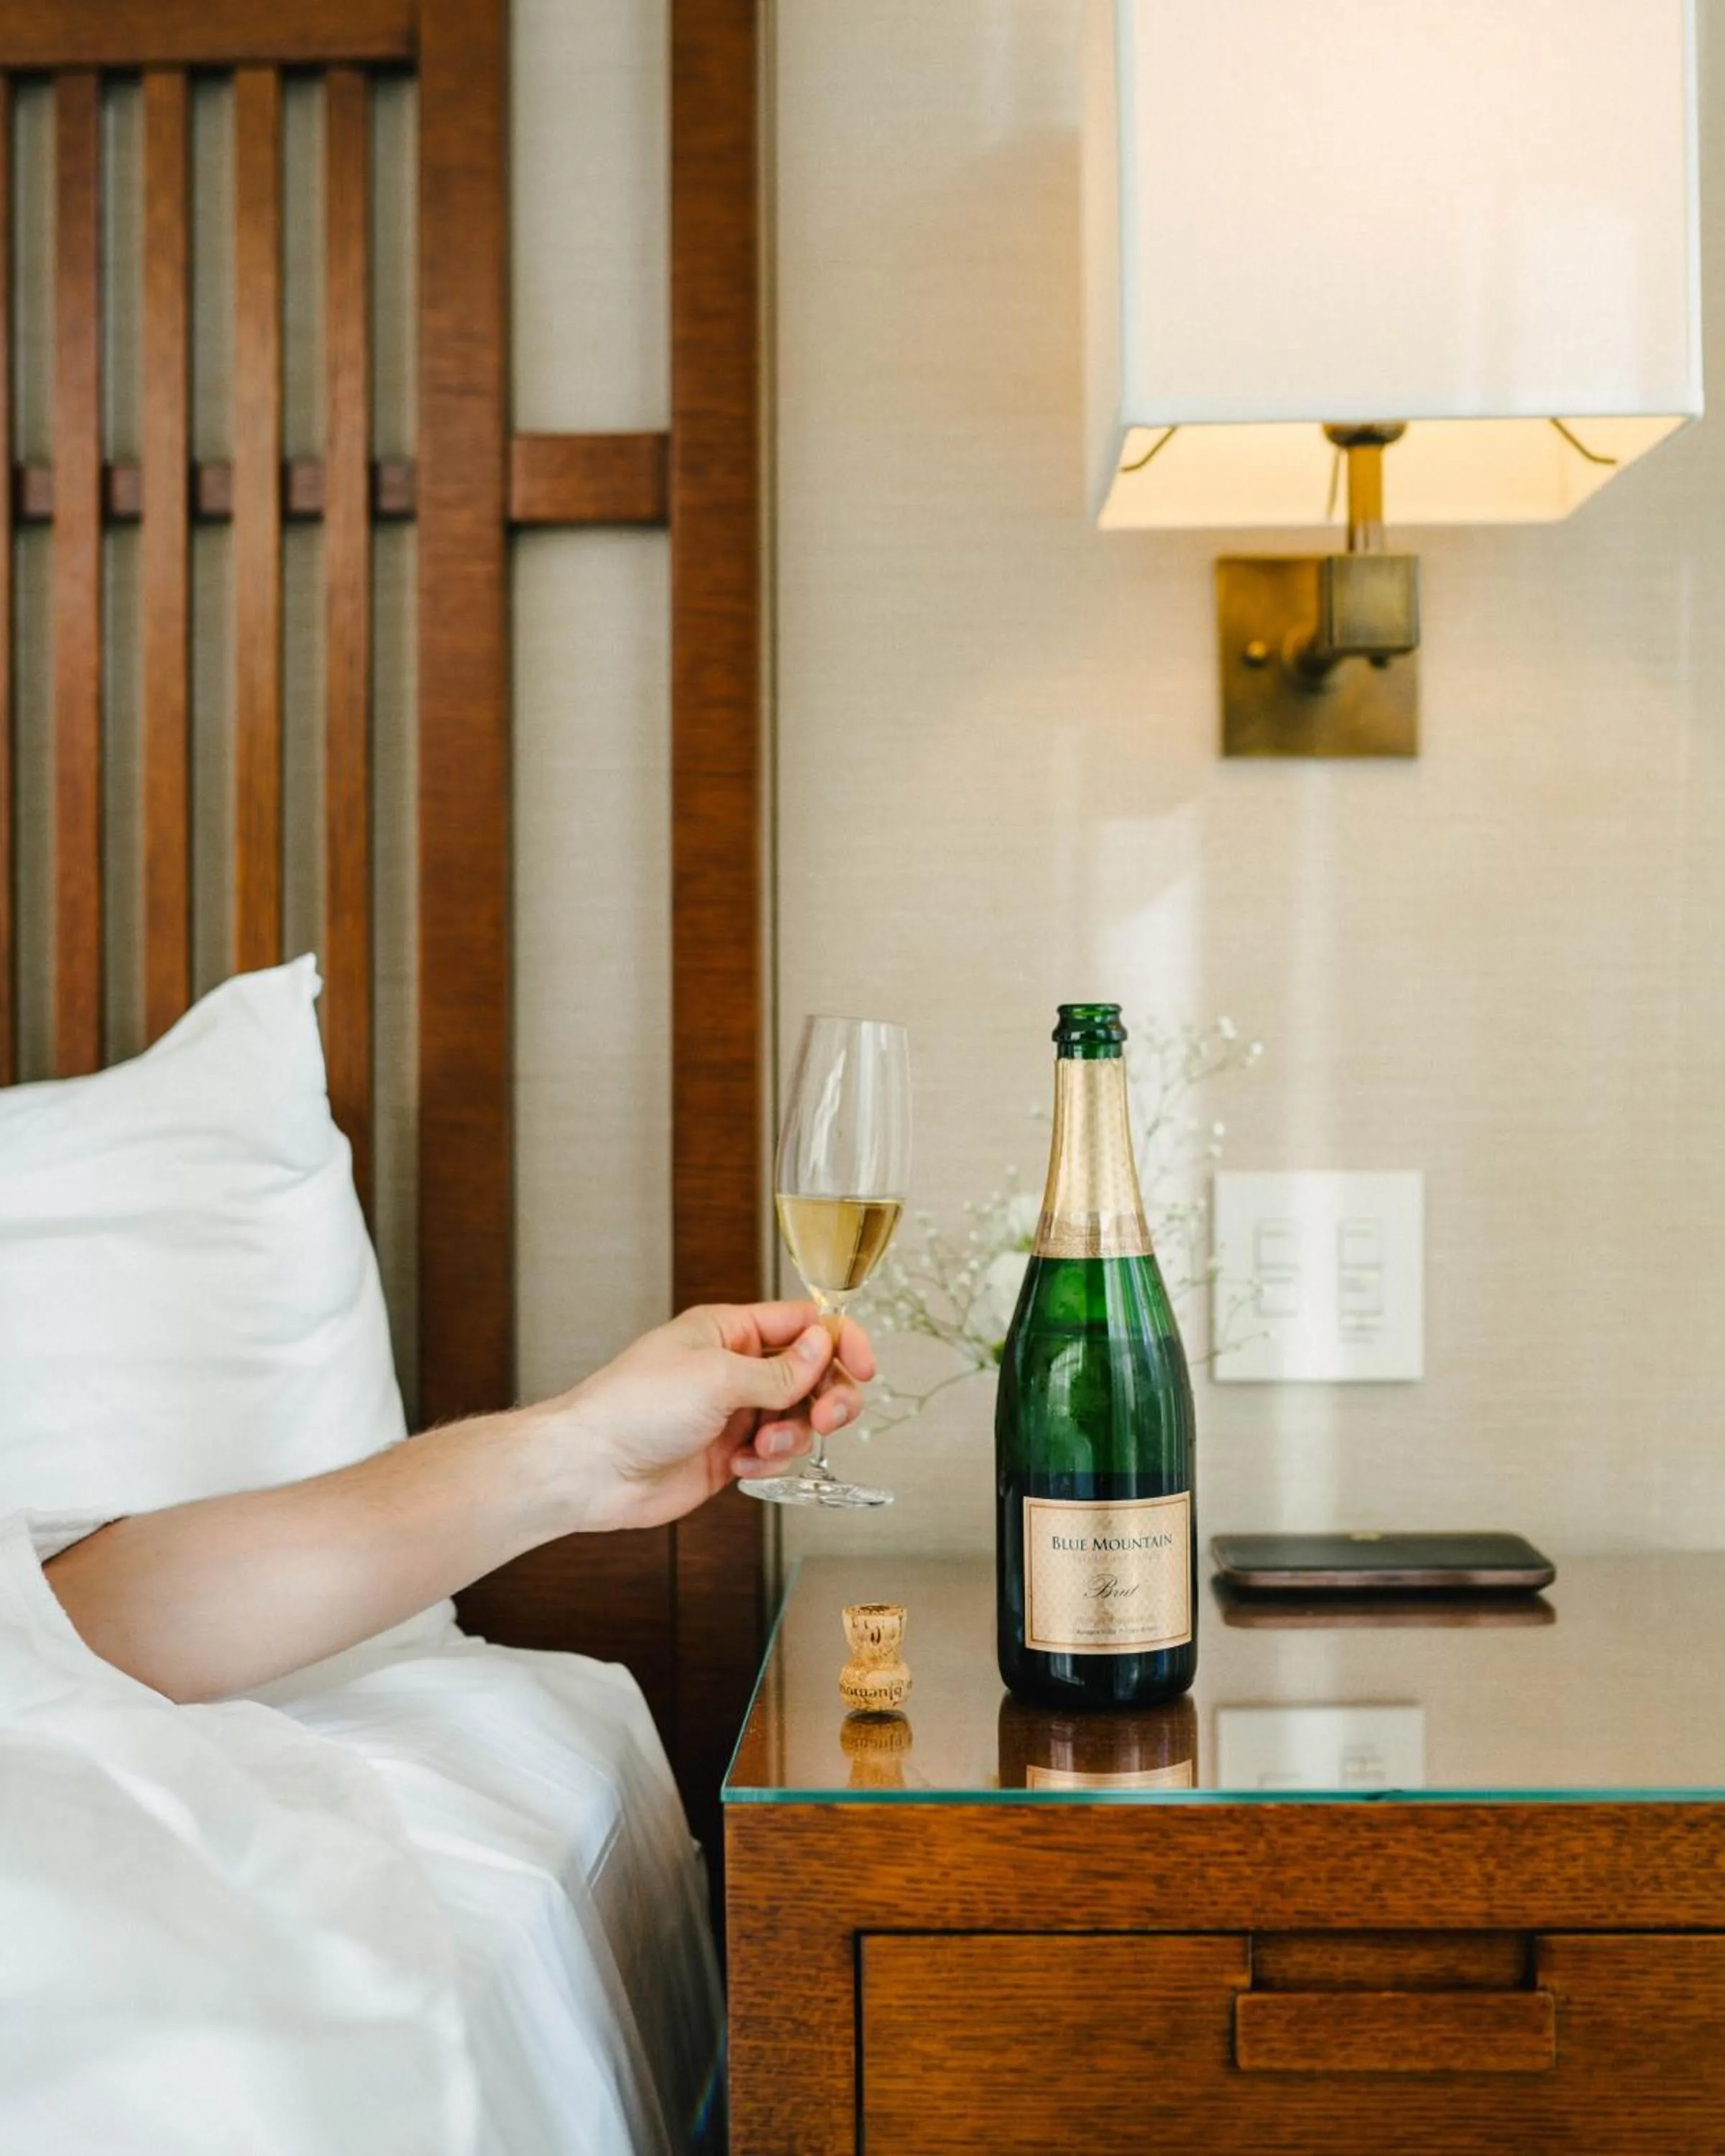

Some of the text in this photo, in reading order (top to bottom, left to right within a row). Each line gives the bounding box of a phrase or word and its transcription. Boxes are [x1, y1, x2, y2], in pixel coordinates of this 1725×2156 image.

[1052, 1534, 1172, 1552] BLUE MOUNTAIN
[1084, 1574, 1138, 1599] Brut
